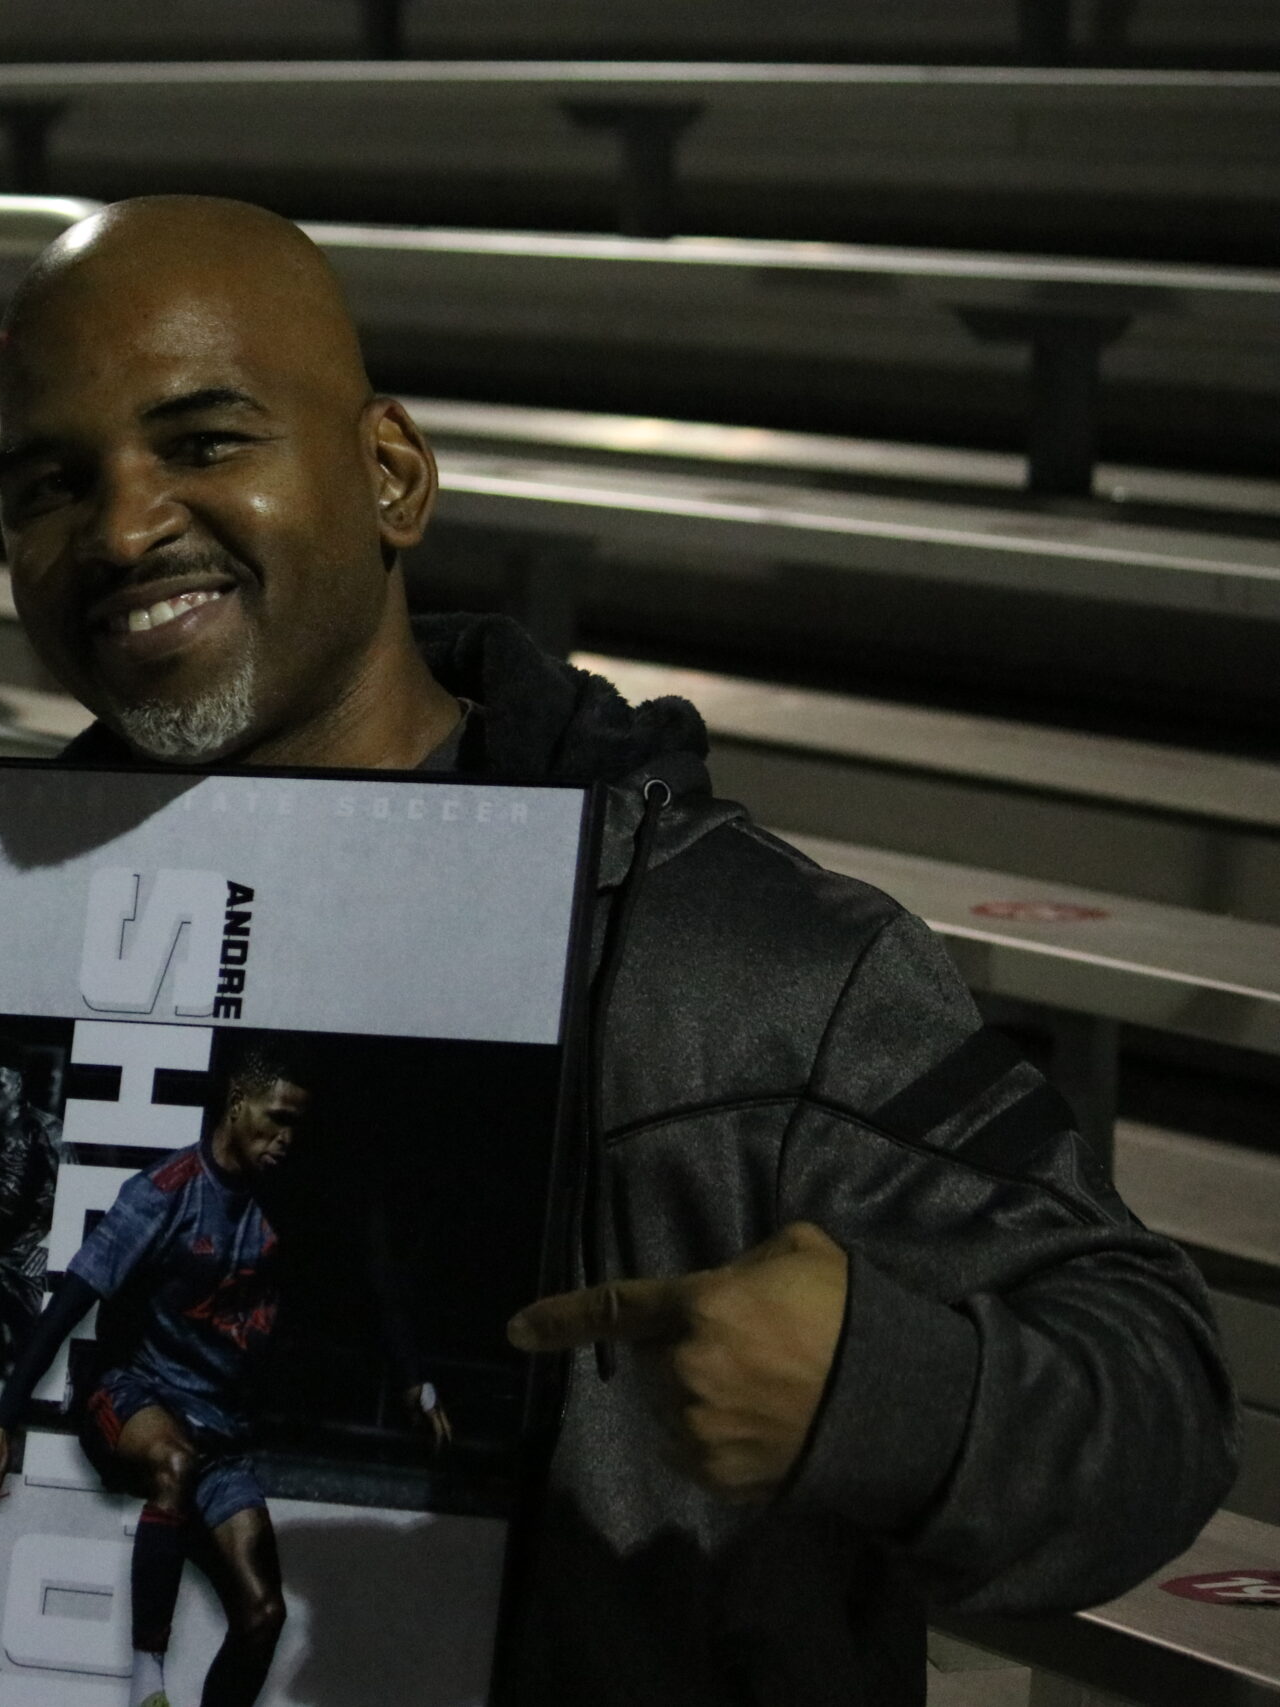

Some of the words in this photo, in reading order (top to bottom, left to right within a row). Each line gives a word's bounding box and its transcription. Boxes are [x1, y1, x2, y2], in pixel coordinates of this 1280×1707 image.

[183, 790, 291, 815] TATE
[334, 795, 528, 824] SOCCER
[212, 880, 254, 1020] ANDRE
